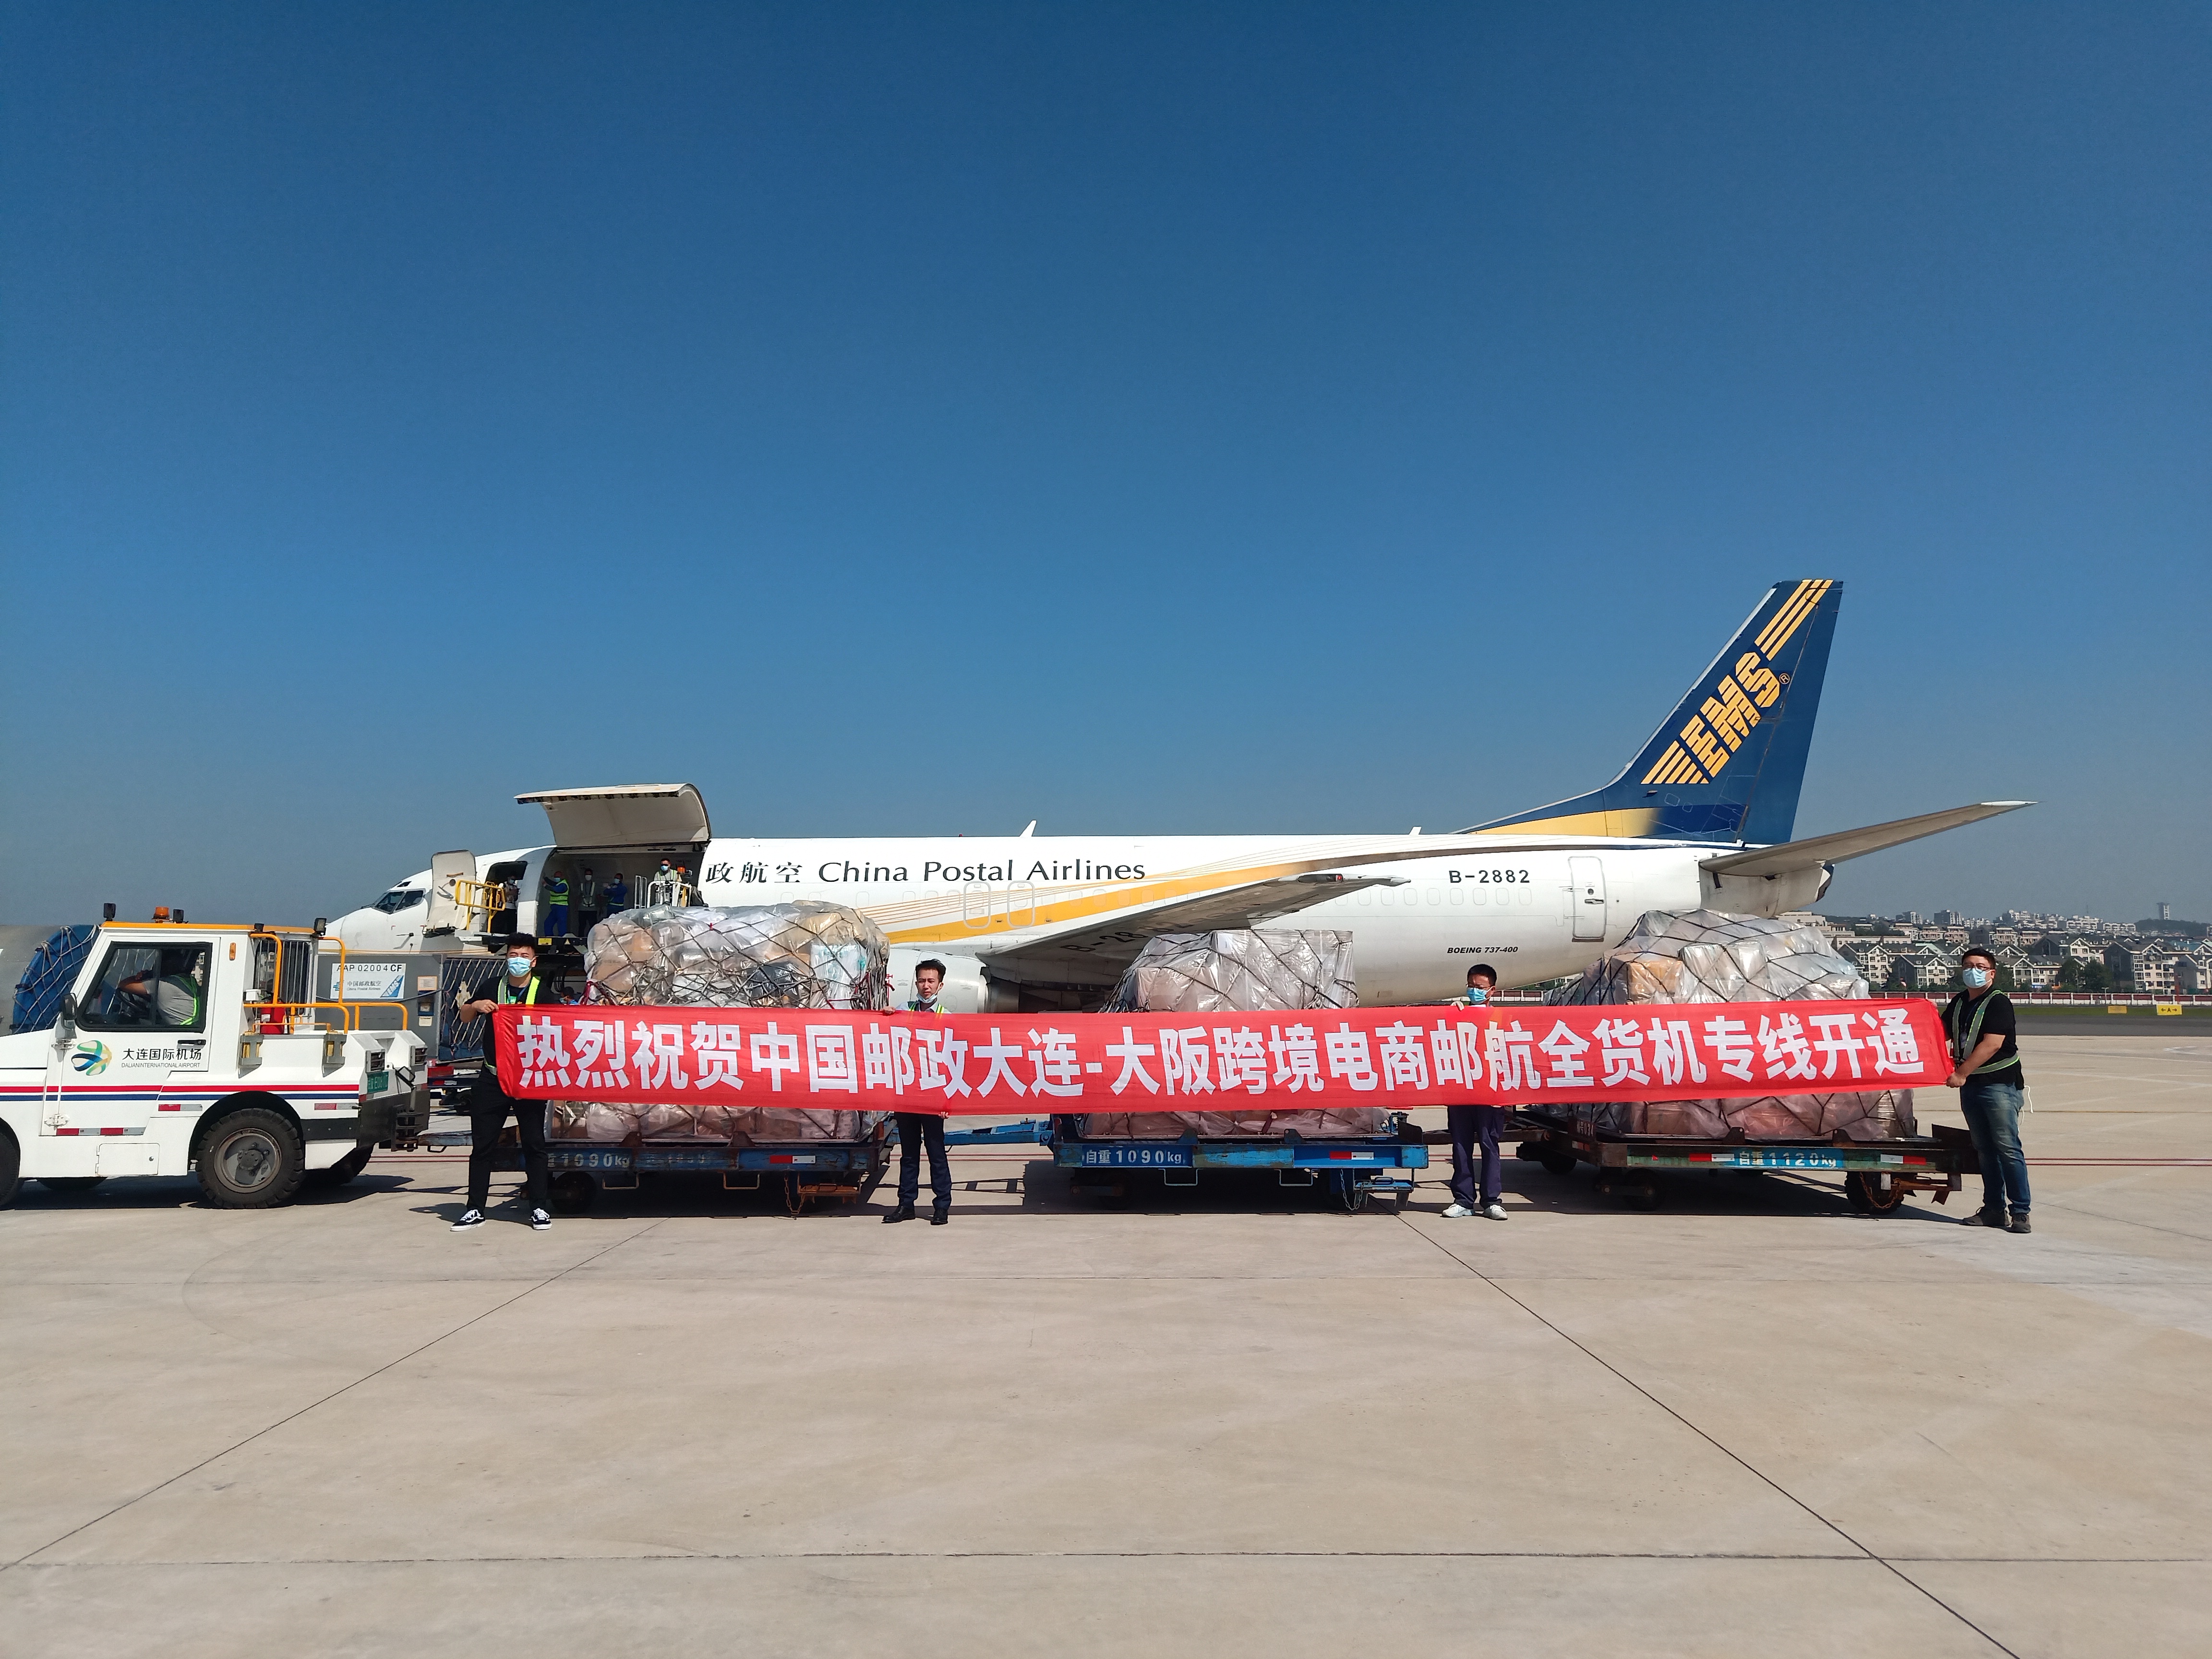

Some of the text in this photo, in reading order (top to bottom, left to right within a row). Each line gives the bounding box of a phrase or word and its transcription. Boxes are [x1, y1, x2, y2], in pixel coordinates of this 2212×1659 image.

[1680, 651, 1780, 778] EMS
[706, 859, 1145, 884] 政航空 China Postal Airlines
[1449, 869, 1530, 883] B-2882
[390, 964, 402, 972] CF
[122, 1048, 202, 1060] 大连国际机场
[516, 1008, 1924, 1099] 热烈祝贺中国邮政大连-大阪跨境电商邮航全货机专线开通
